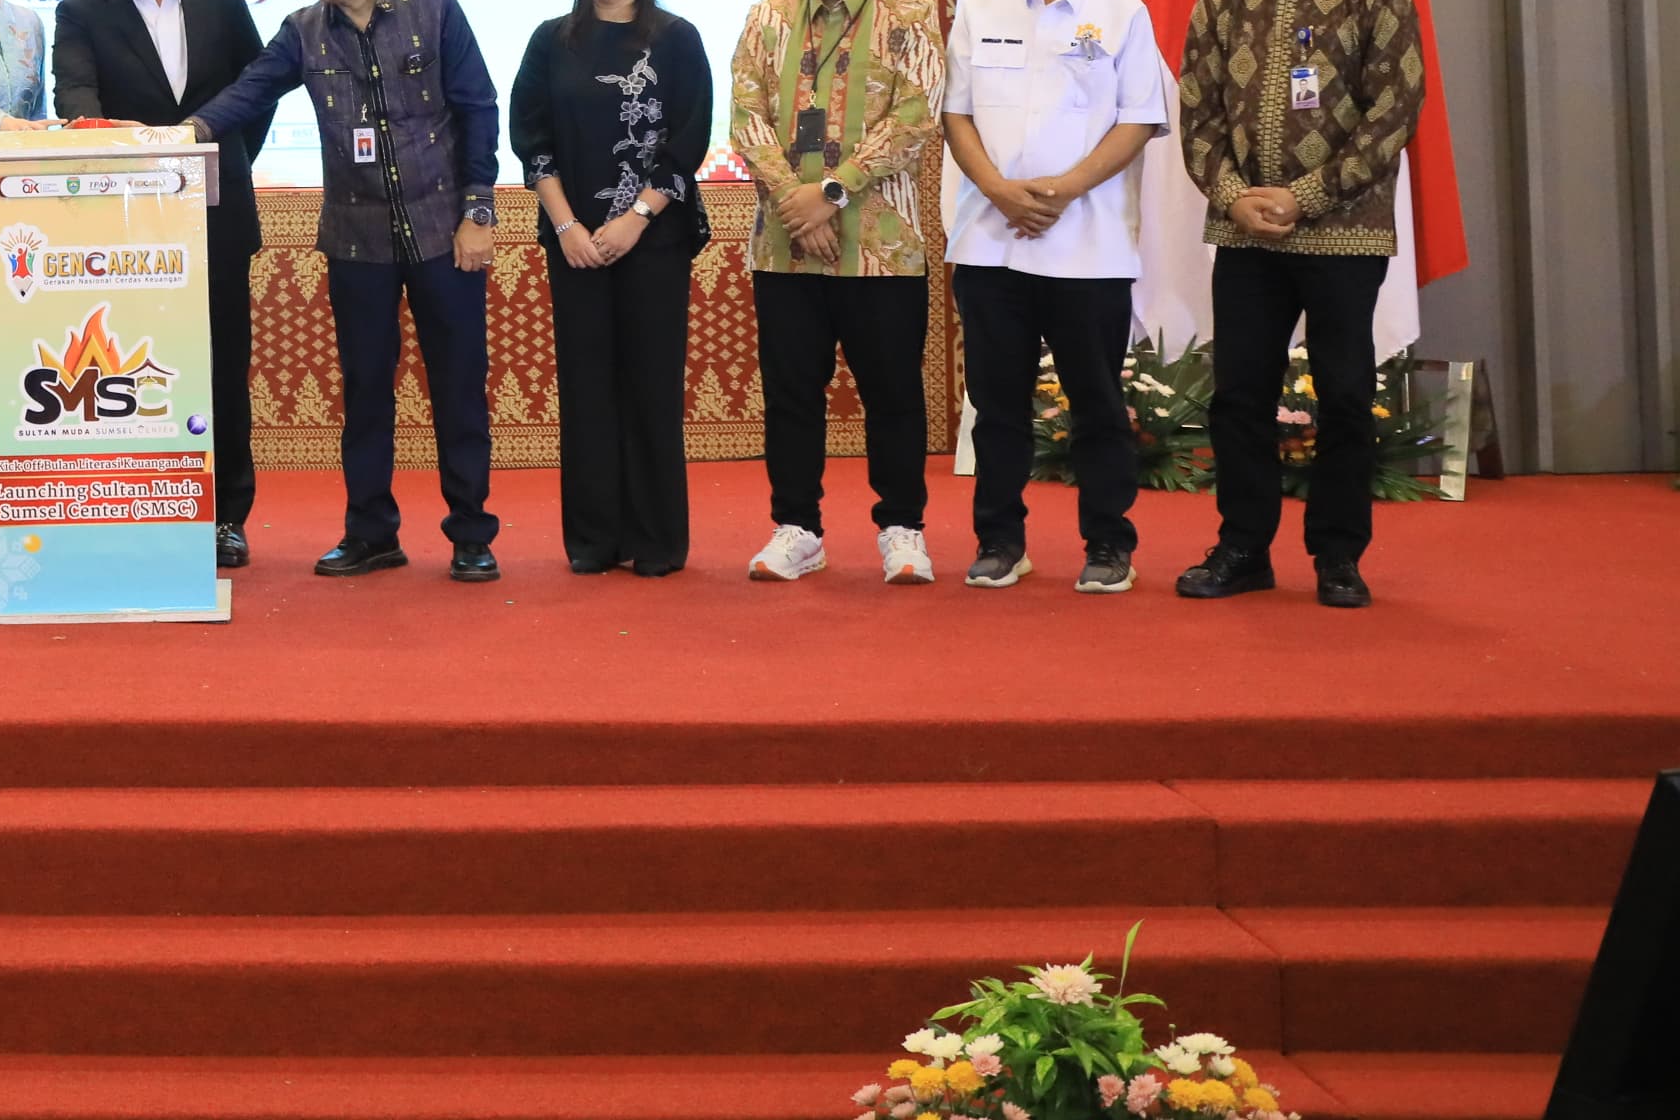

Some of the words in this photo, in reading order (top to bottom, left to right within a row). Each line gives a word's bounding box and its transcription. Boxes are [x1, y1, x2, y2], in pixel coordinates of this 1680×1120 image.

[43, 249, 183, 277] GENCARKAN
[43, 278, 76, 286] Gerakan
[79, 277, 111, 285] Nasional
[115, 276, 142, 285] Cerdas
[144, 276, 183, 285] Keuangan
[24, 368, 168, 425] SMSC
[18, 429, 57, 437] SULTAN
[62, 428, 90, 436] MUDA
[95, 427, 133, 435] SUMSEL
[23, 459, 42, 471] Off
[44, 459, 80, 470] Bulan
[79, 458, 121, 470] Literasi
[123, 458, 181, 470] Keuangan
[182, 456, 203, 468] dan
[91, 482, 148, 498] Sultan
[152, 481, 201, 497] Muda
[0, 504, 63, 520] Sumsel
[68, 503, 128, 518] Center
[132, 499, 198, 519] (SMSC)
